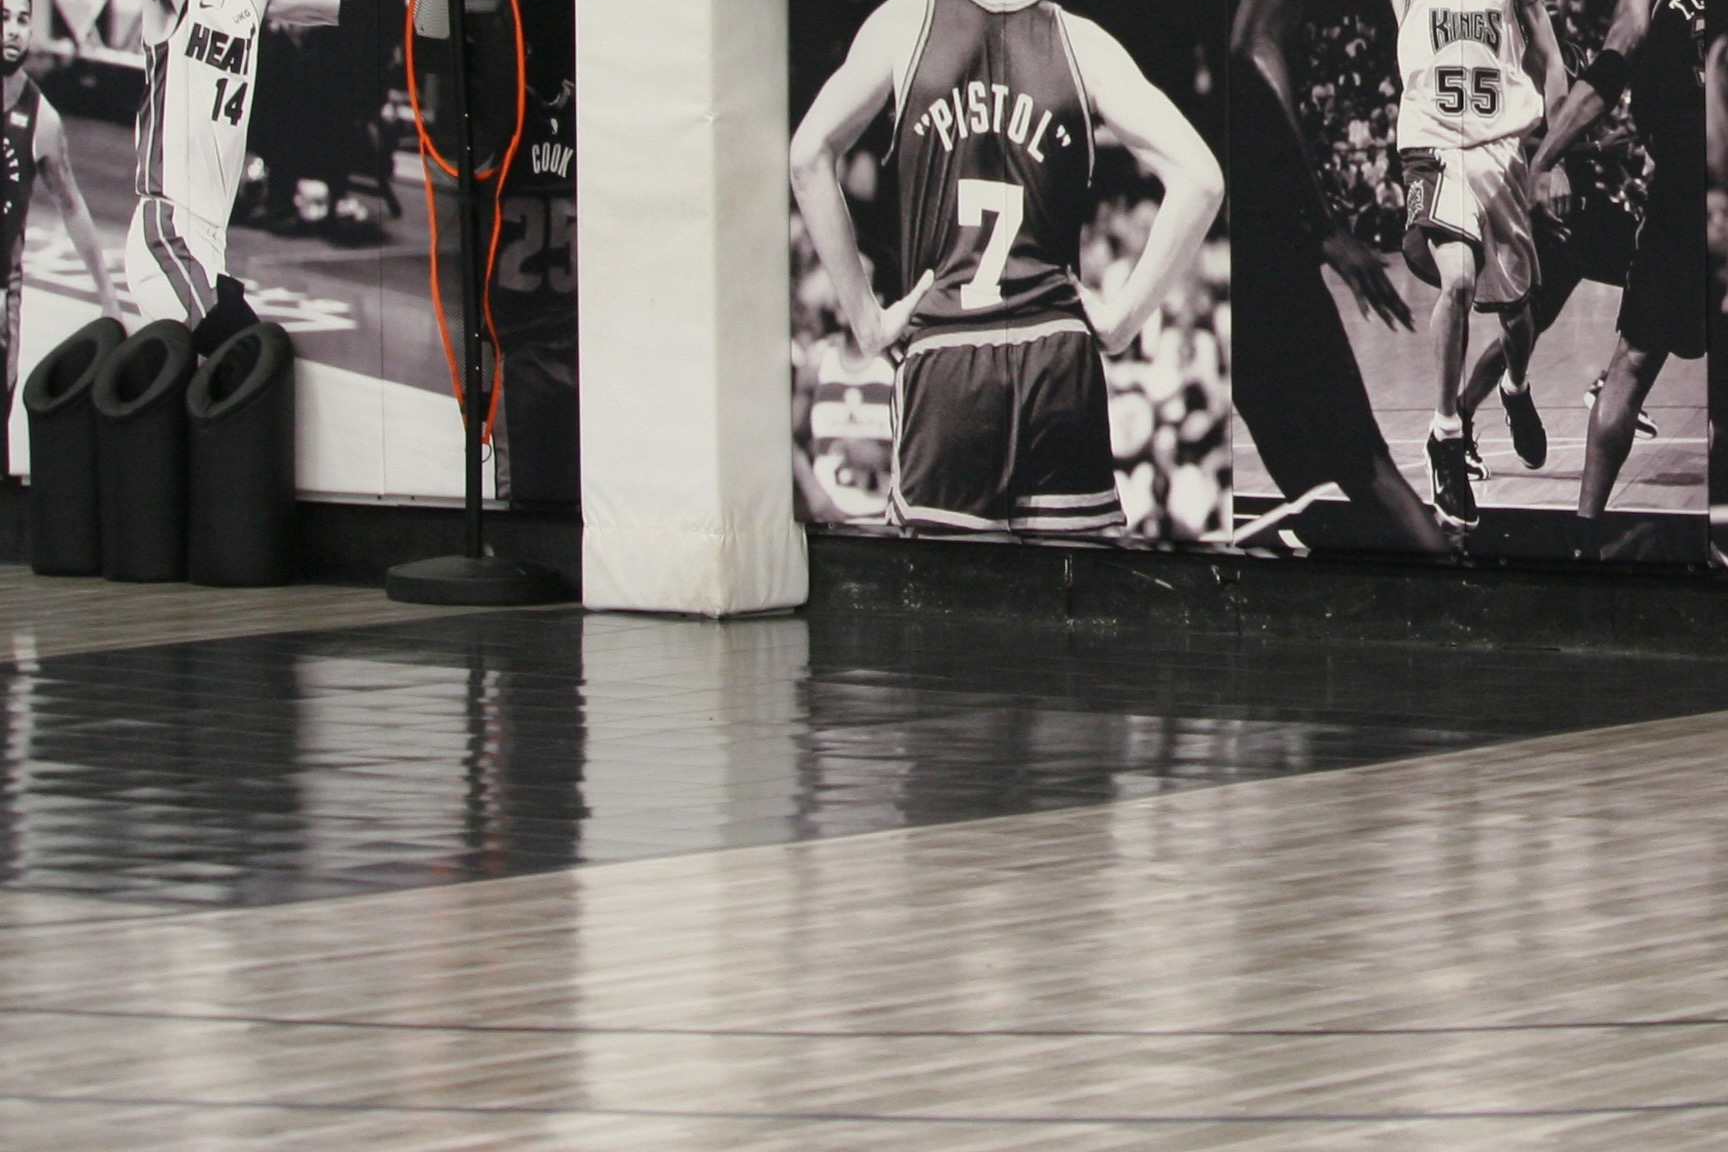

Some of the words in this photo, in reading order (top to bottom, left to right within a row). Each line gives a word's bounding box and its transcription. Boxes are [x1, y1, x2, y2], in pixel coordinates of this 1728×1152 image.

[184, 22, 256, 76] HEAT
[1428, 7, 1503, 59] KINGS
[211, 78, 248, 127] 14
[1434, 65, 1502, 119] 55
[532, 142, 574, 178] COOK
[958, 179, 1024, 310] 7
